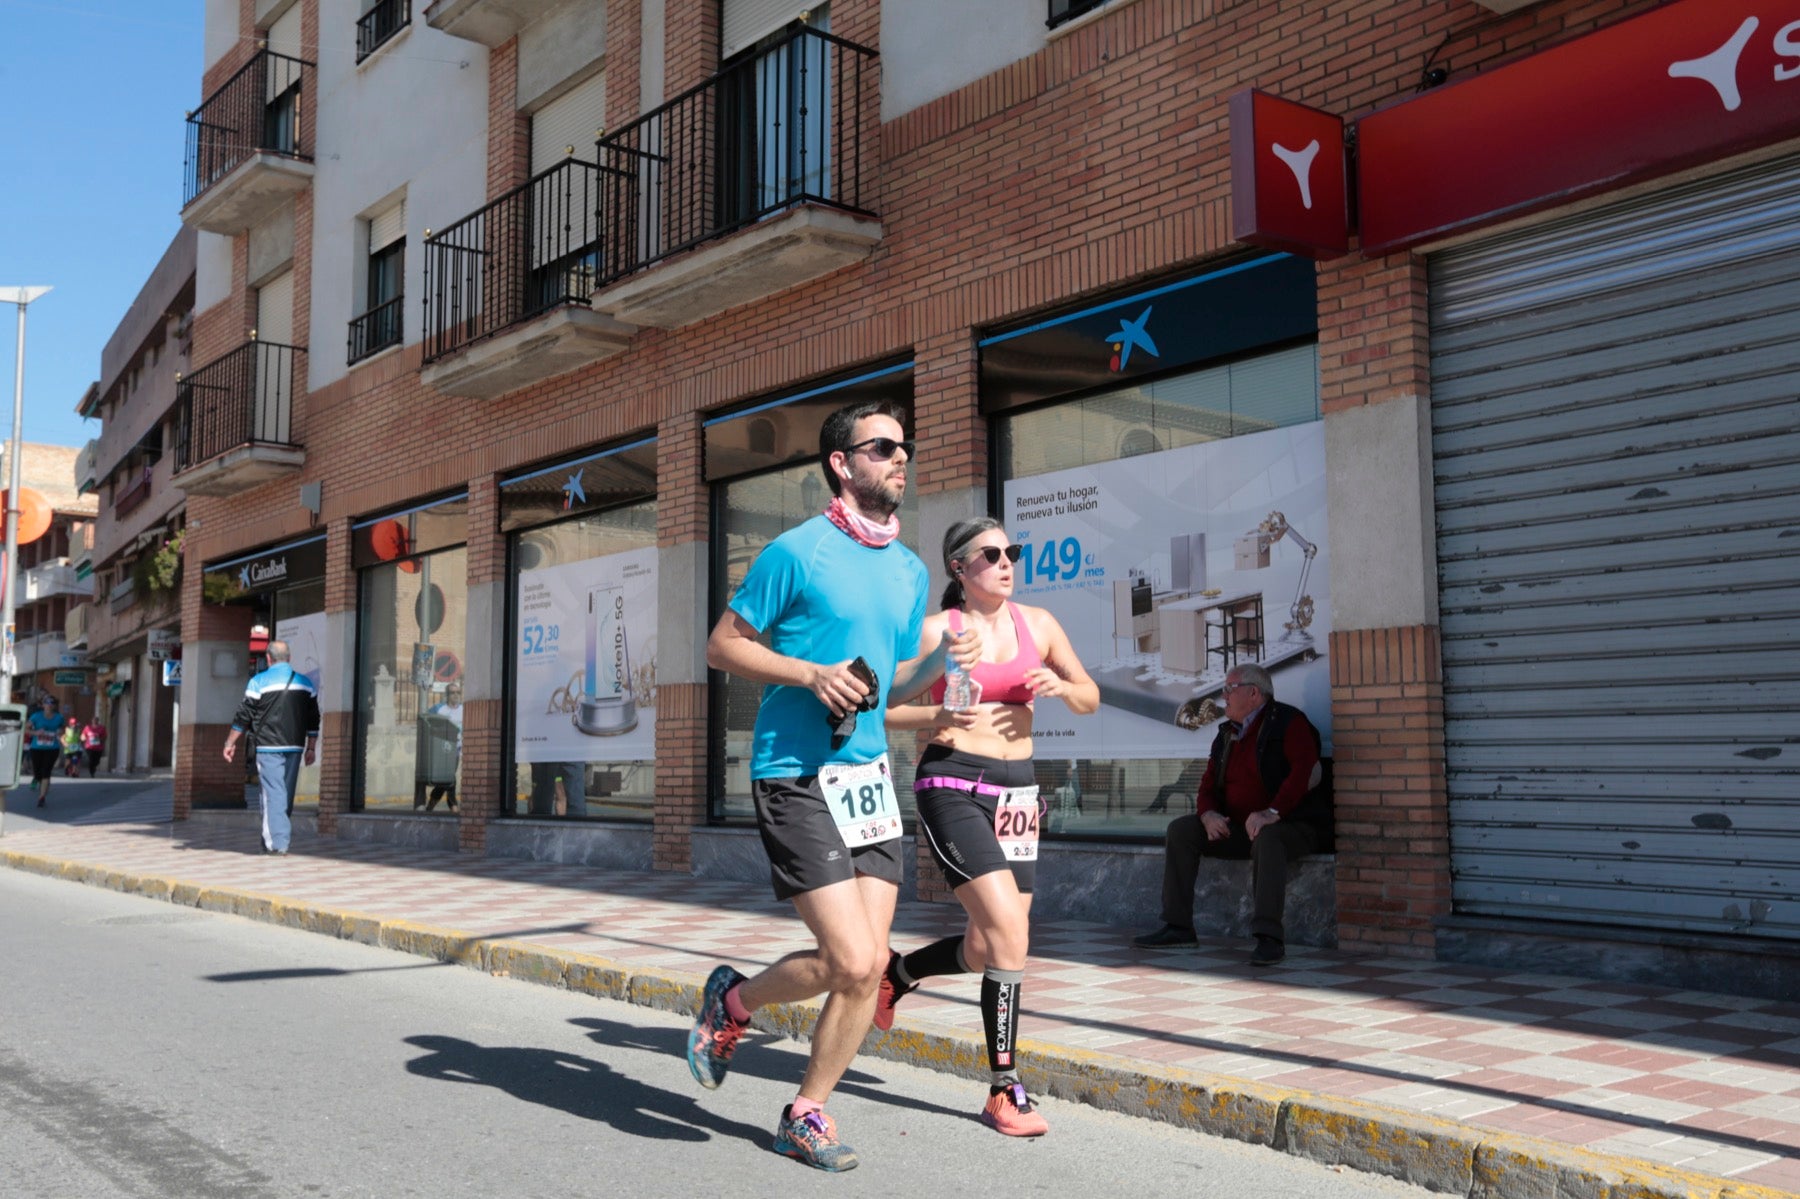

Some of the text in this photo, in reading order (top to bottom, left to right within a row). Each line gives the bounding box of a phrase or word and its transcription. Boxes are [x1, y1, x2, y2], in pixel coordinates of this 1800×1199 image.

[1016, 486, 1099, 508] Renueva tu hogar,
[1016, 497, 1098, 521] renueva tu ilusión
[1016, 531, 1030, 541] por
[251, 555, 287, 582] CaixaBank
[1020, 536, 1081, 585] 149
[1084, 567, 1105, 578] mes
[614, 595, 623, 620] 5G
[1062, 728, 1076, 737] vida
[840, 782, 886, 819] 187
[998, 810, 1037, 836] 204
